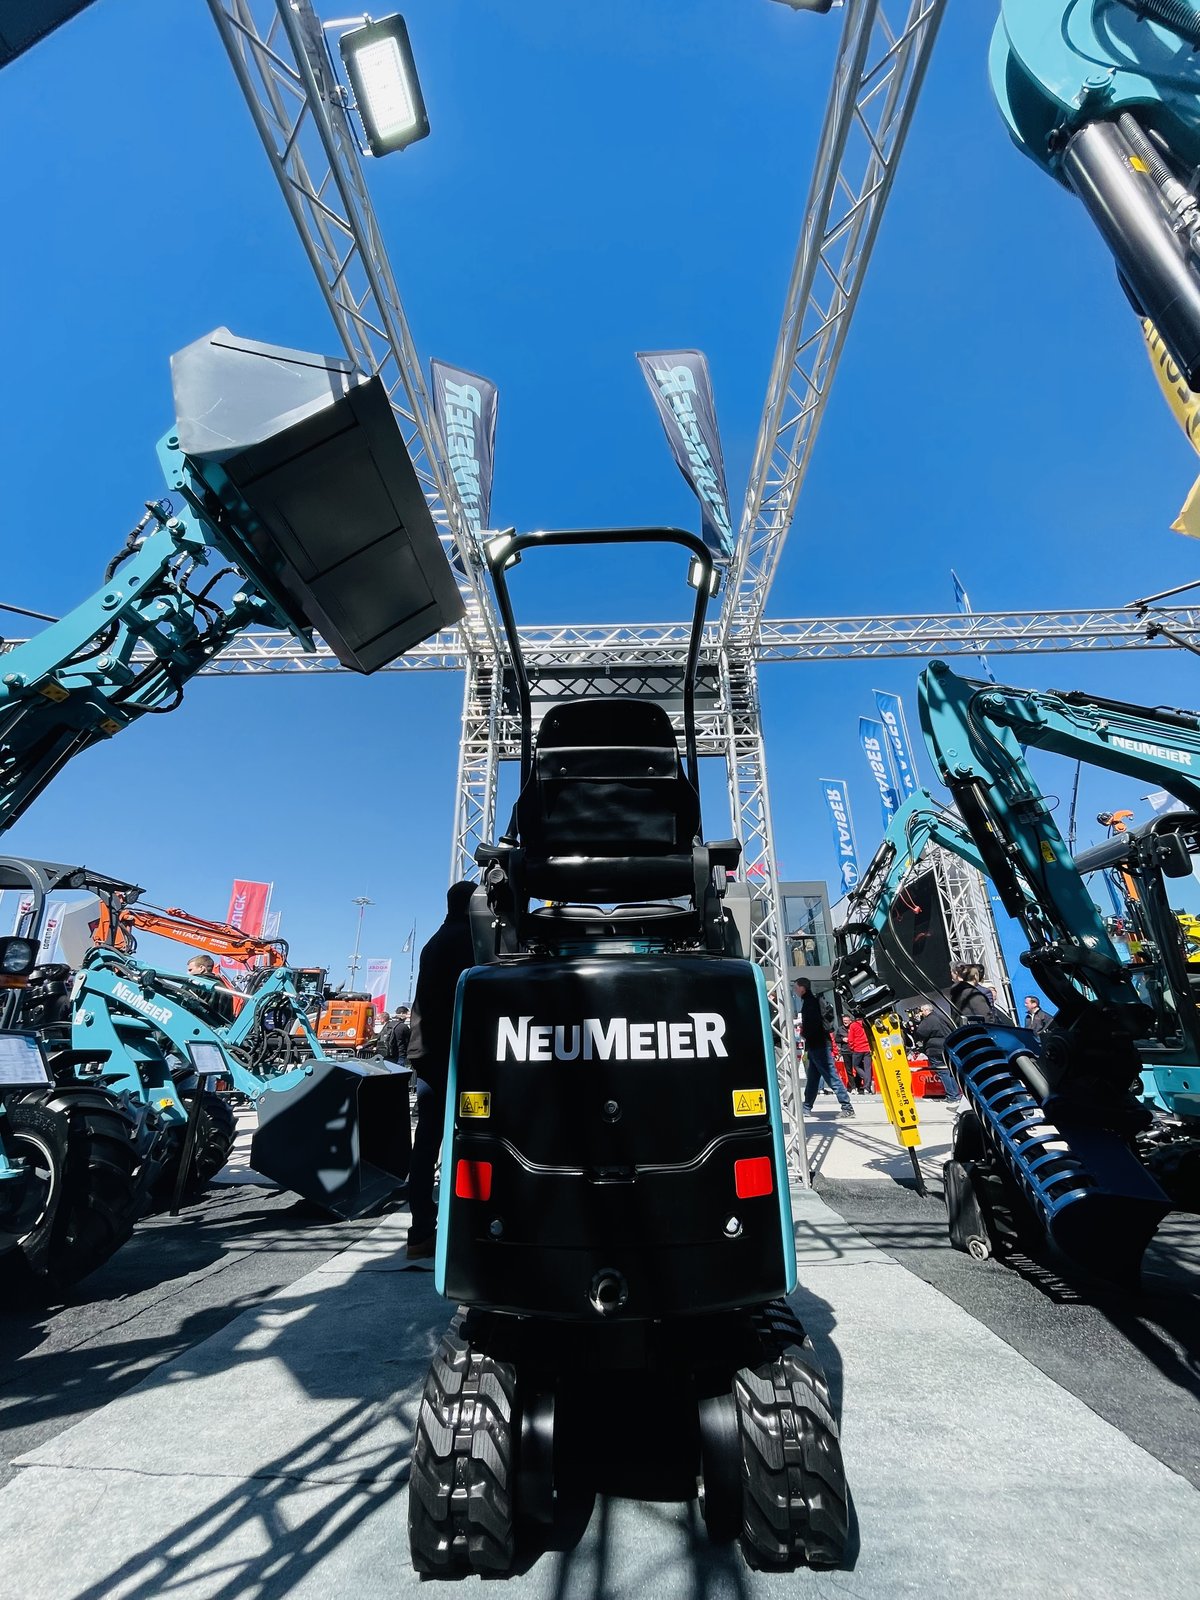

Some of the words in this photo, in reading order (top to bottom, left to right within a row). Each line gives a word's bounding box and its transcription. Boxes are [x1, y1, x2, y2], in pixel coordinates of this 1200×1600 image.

[1112, 736, 1192, 766] NEUMEIER
[172, 929, 207, 943] HITACHI
[111, 981, 173, 1025] NEUMEIER
[496, 1013, 729, 1061] NEUMEIER
